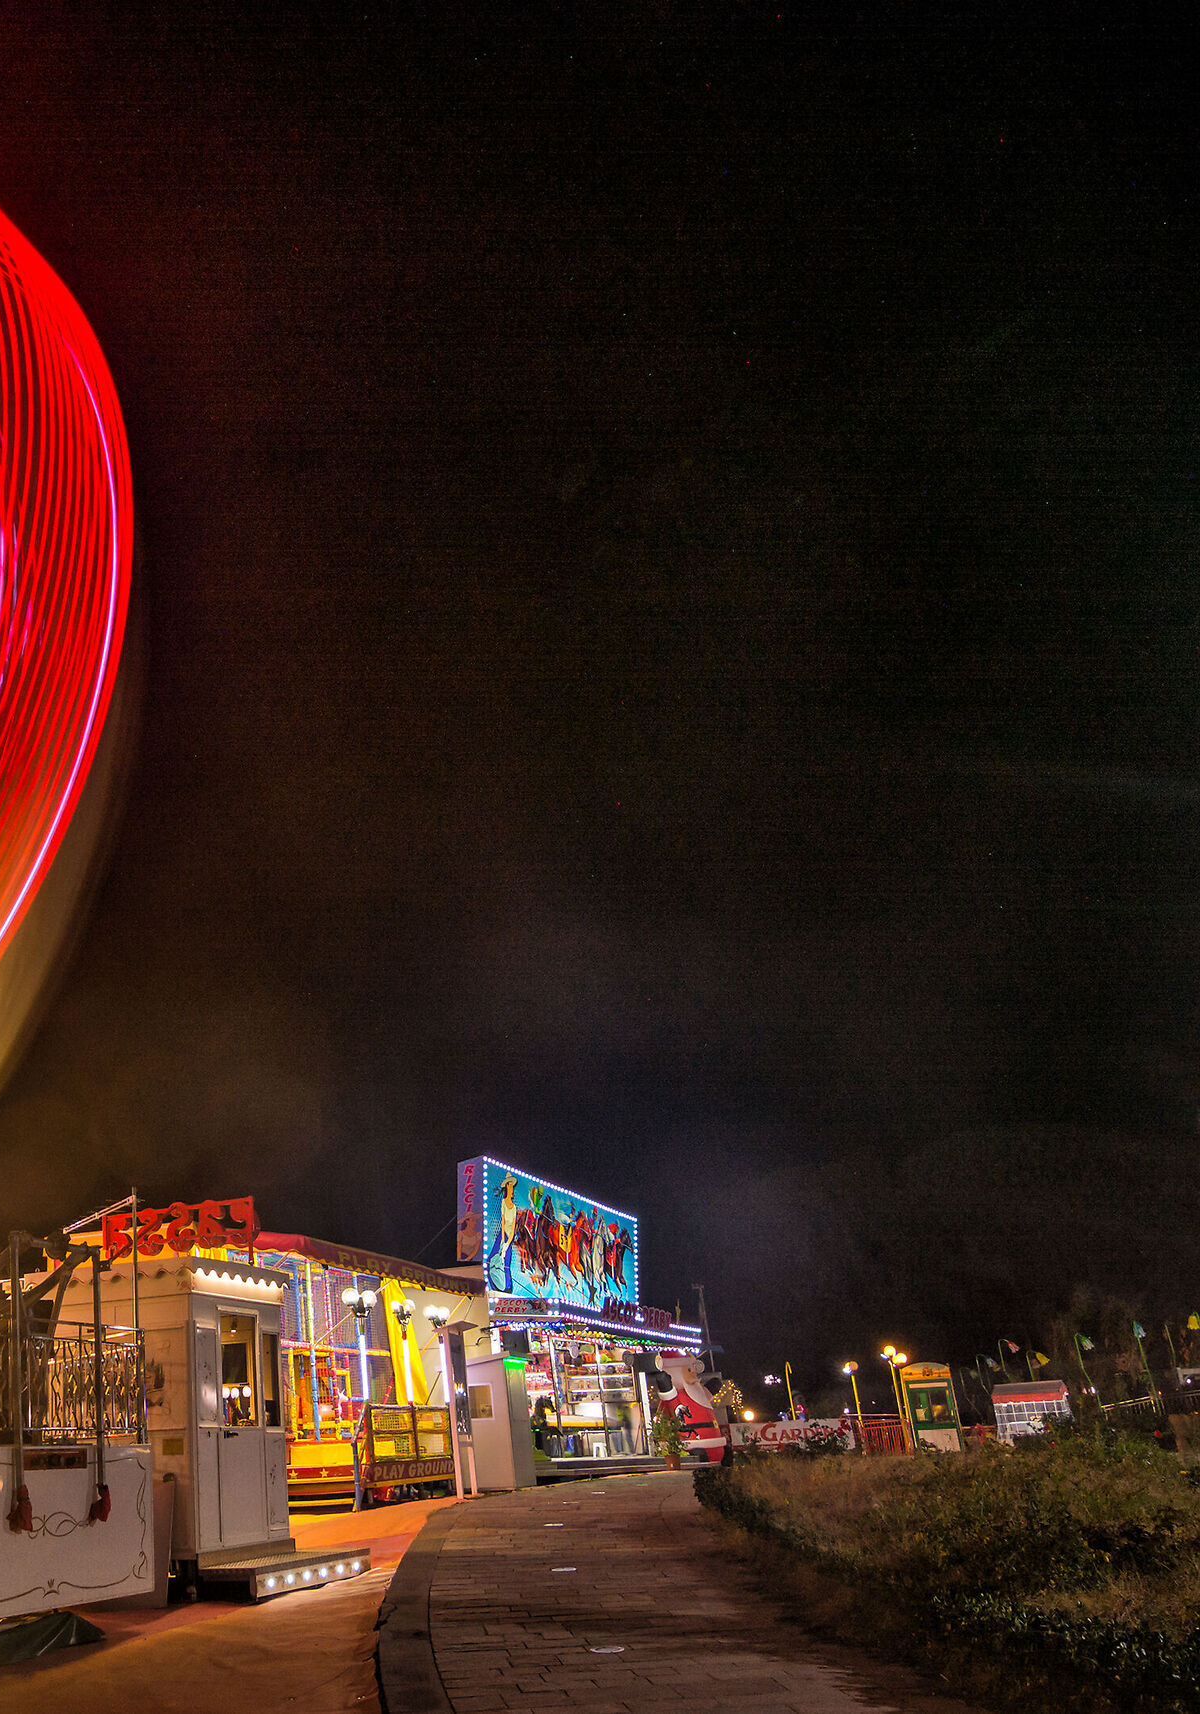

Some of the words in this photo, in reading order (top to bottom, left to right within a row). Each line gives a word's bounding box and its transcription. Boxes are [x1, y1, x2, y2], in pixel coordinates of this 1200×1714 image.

[463, 1164, 476, 1214] RICCI
[338, 1251, 391, 1273] PLAY
[401, 1265, 470, 1291] GROUND
[601, 1296, 638, 1325] ASCOT
[640, 1306, 672, 1332] DERBY
[374, 1464, 405, 1480] PLAY
[408, 1460, 455, 1478] GROUND
